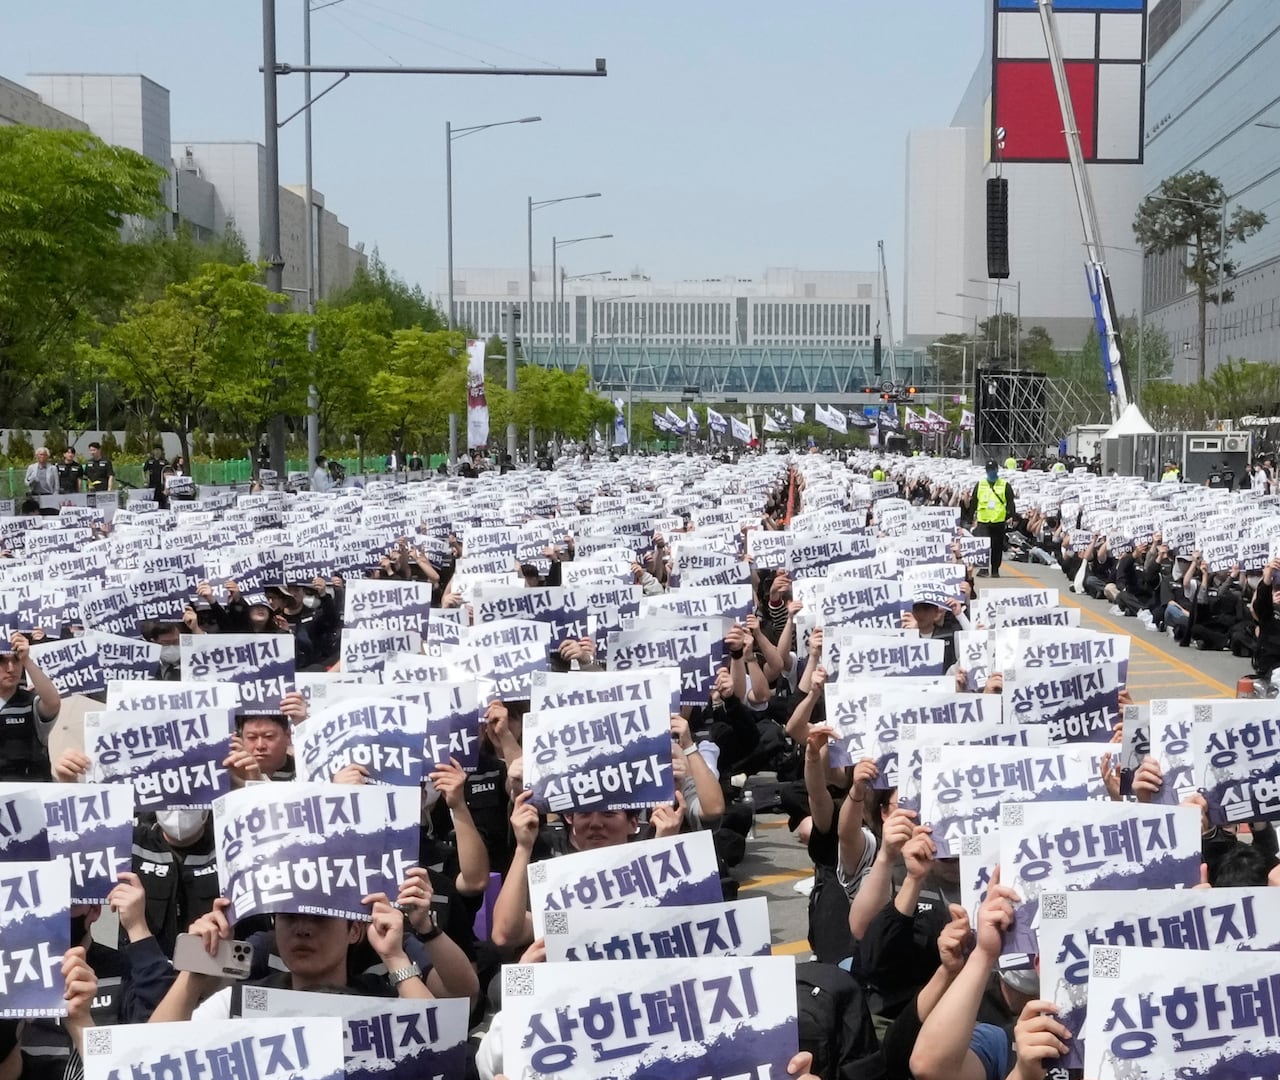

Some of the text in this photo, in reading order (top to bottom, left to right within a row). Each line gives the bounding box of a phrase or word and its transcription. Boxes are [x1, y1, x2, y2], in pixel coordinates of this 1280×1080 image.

[478, 590, 553, 620] 상한폐지
[822, 585, 889, 615] 상한폐지
[188, 638, 280, 676] 상한폐지
[346, 635, 412, 662] 상한폐지
[613, 633, 697, 672] 상한폐지
[847, 644, 929, 674] 상한폐지
[1012, 668, 1106, 713] 상한폐지
[96, 714, 209, 765] 상한폐지
[530, 705, 652, 768] 상한폐지
[543, 754, 672, 812] 실현하자
[934, 756, 1067, 801] 상한폐지
[607, 800, 674, 810] 삼성전자노동조합 공동투쟁본부
[221, 797, 361, 860] 상한폐지
[1015, 813, 1179, 881] 상한폐지
[139, 860, 169, 877] 투쟁
[228, 854, 381, 919] 실현하자
[298, 906, 344, 916] 삼성전자노동조합
[26, 1007, 68, 1016] 공동투쟁본부
[525, 967, 760, 1073] 상한폐지
